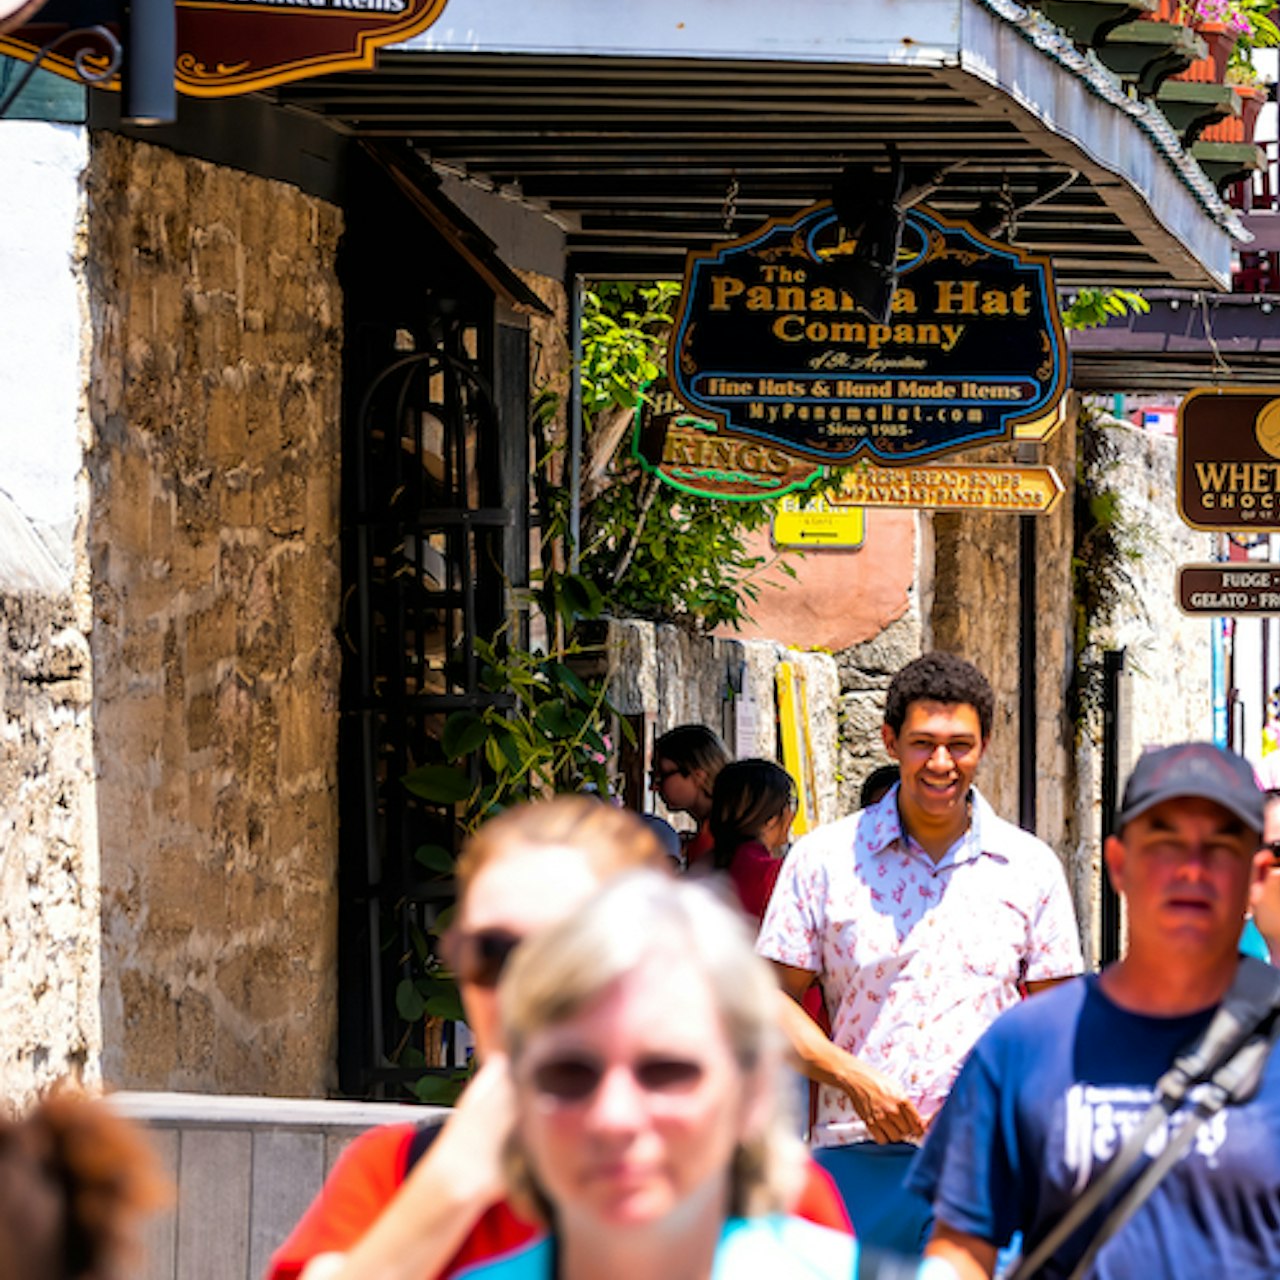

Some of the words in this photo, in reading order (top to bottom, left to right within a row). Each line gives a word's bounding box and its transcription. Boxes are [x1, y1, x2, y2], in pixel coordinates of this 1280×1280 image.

[759, 265, 807, 283] The
[933, 280, 1033, 316] Hat
[771, 314, 965, 352] Company
[708, 377, 753, 396] Fine
[758, 378, 806, 397] Hats
[810, 380, 831, 397] &
[836, 381, 892, 398] Hand
[897, 381, 957, 399] Made
[961, 382, 1022, 400] Items
[1222, 573, 1274, 588] FUDGE
[1189, 593, 1249, 608] GELATO
